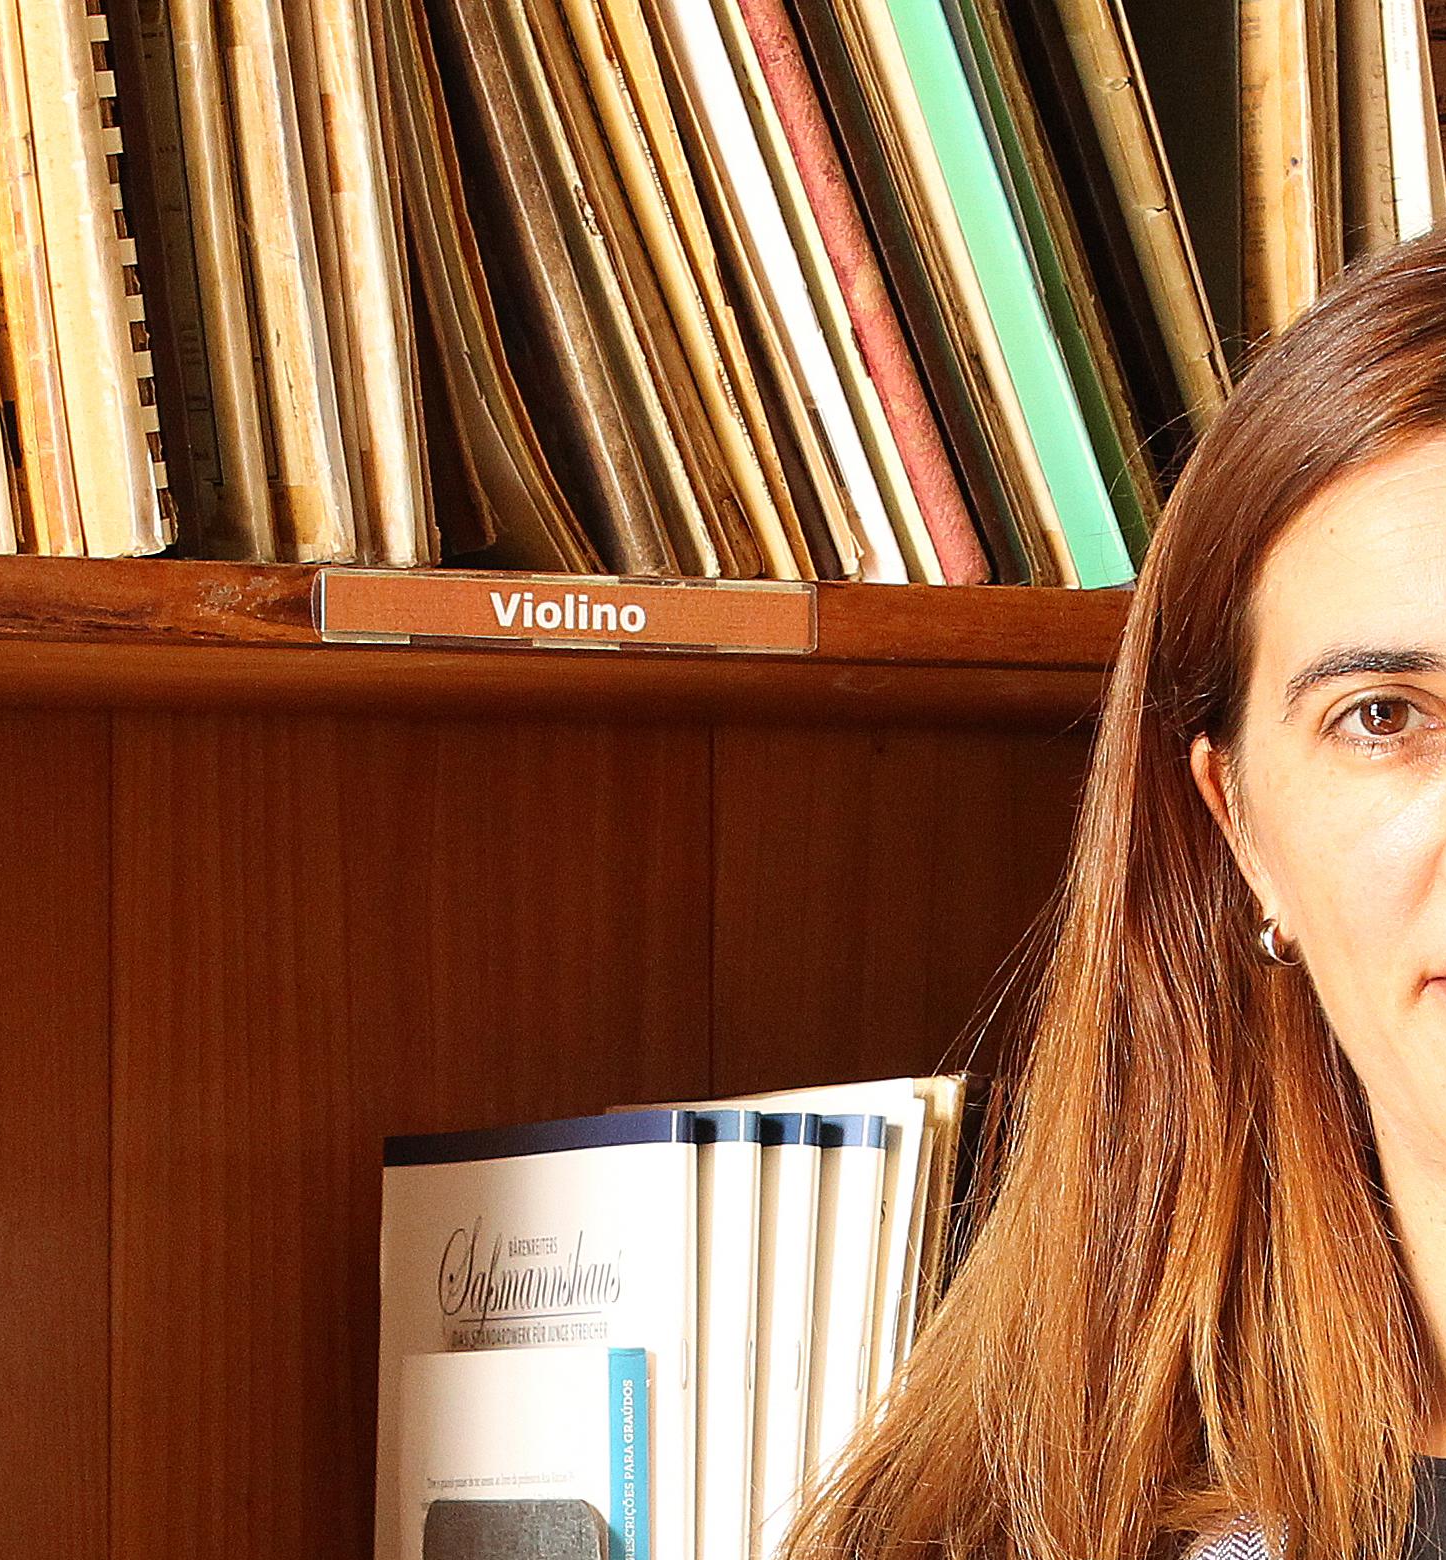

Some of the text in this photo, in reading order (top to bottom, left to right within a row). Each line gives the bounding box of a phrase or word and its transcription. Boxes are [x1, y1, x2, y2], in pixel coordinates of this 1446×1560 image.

[489, 591, 647, 633] Violino
[620, 1378, 635, 1443] GRAÚDOS
[623, 1444, 636, 1480] PARA
